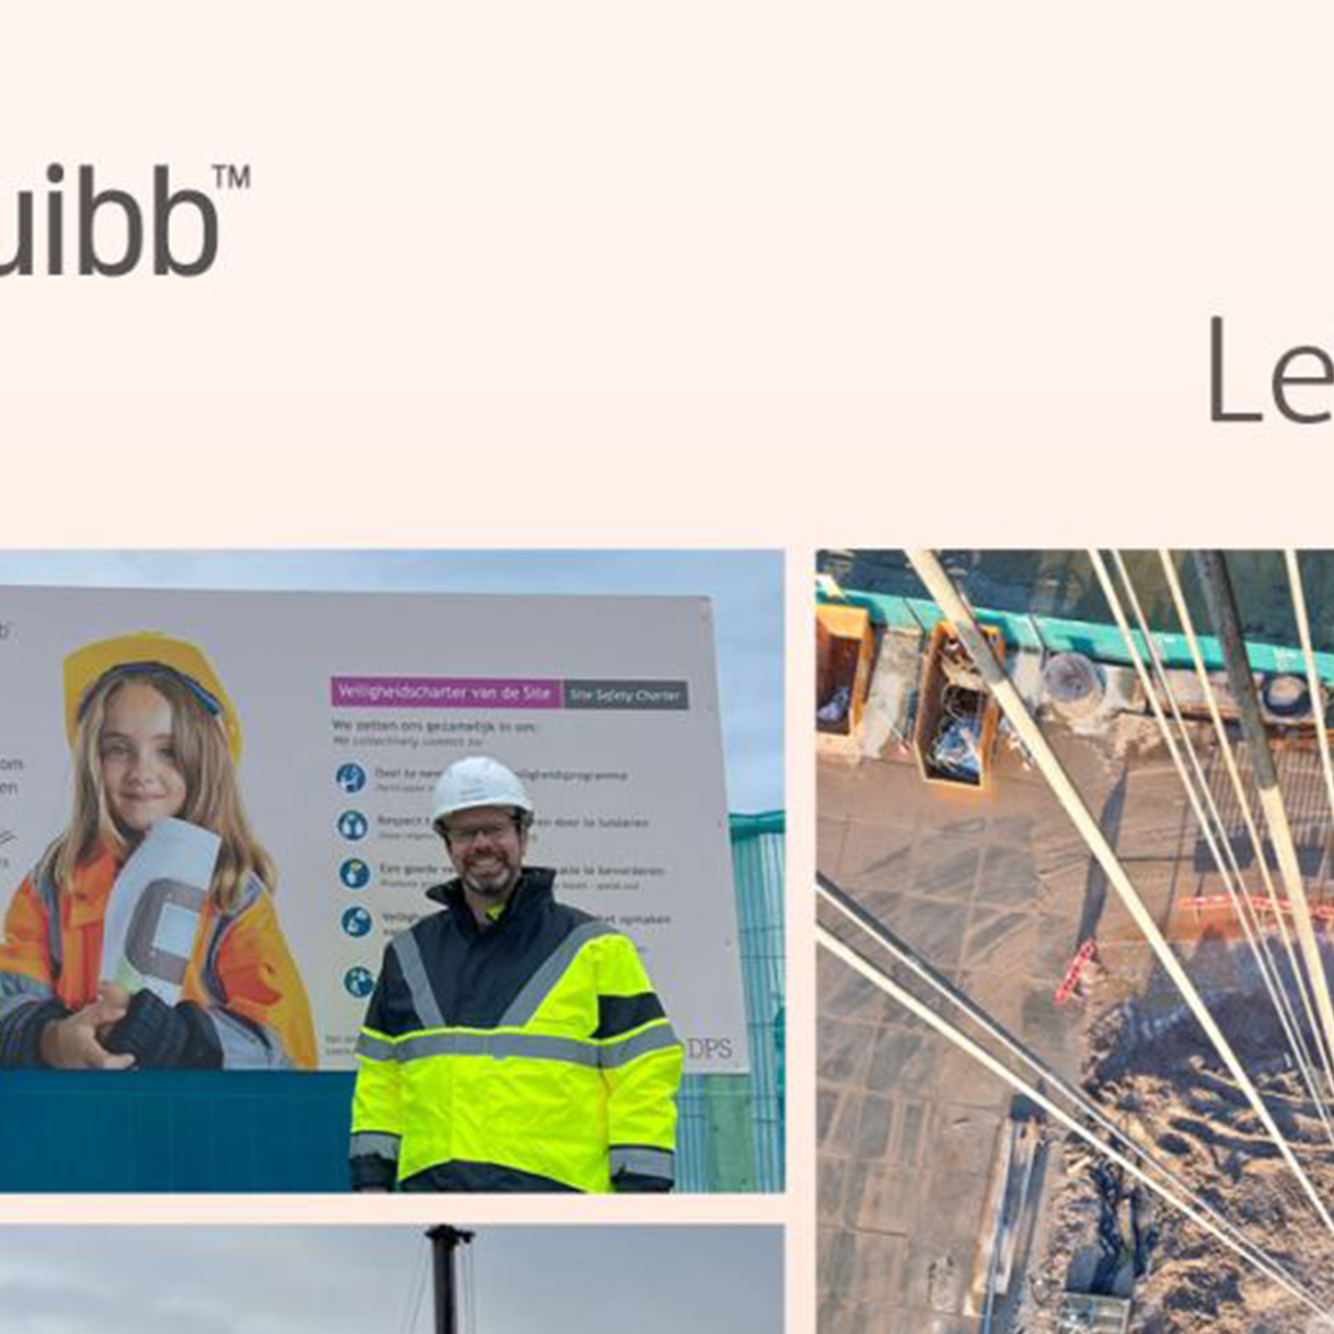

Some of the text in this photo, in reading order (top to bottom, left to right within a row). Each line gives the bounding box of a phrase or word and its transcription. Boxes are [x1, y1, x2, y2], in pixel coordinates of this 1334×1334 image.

[473, 687, 497, 699] van
[500, 686, 520, 699] de
[523, 686, 552, 700] Site
[569, 689, 593, 700] Site
[596, 689, 634, 704] Safety
[687, 1037, 733, 1060] DPS
